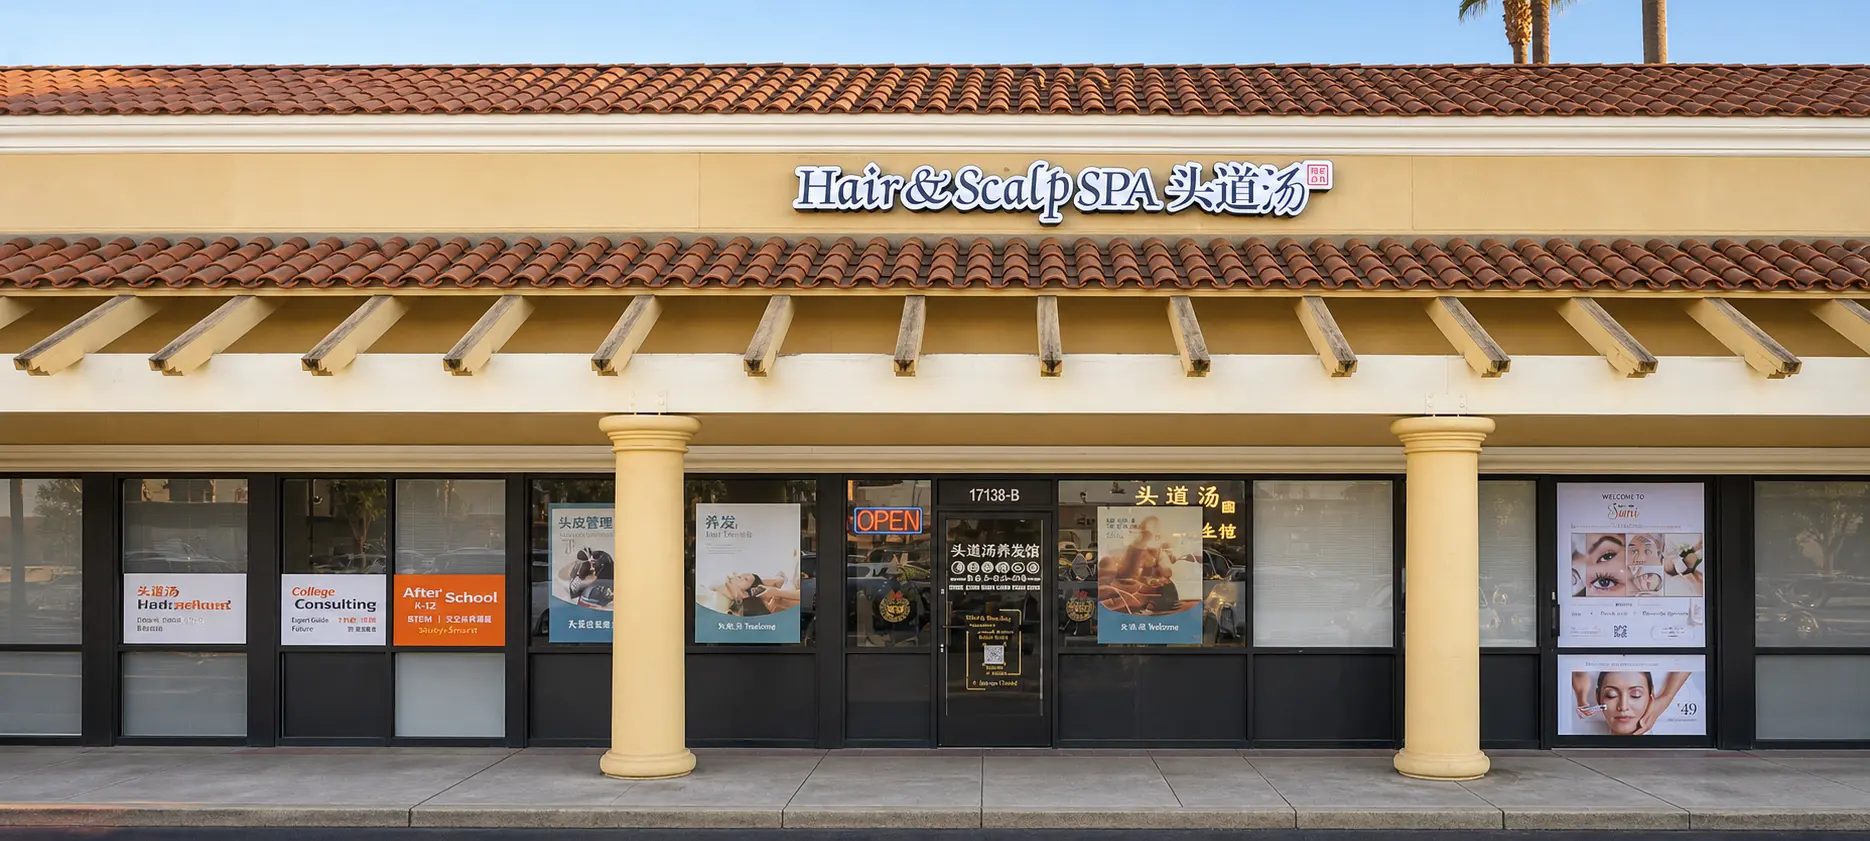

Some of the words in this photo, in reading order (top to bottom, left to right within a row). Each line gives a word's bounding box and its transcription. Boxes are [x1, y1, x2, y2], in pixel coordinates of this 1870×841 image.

[798, 164, 901, 206] Hair
[954, 163, 1071, 219] Scalp
[1077, 170, 1160, 207] SPA
[1168, 164, 1305, 212] 头道汤
[969, 488, 1020, 502] 17138-B
[1135, 485, 1219, 508] 头道汤
[558, 516, 613, 529] 头皮管理
[857, 510, 920, 531] OPEN
[950, 543, 1040, 558] 头道汤养发馆
[291, 587, 335, 598] College
[445, 591, 498, 603] School
[294, 598, 377, 612] Consulting
[414, 601, 437, 610] K-12
[407, 615, 433, 623] STEM
